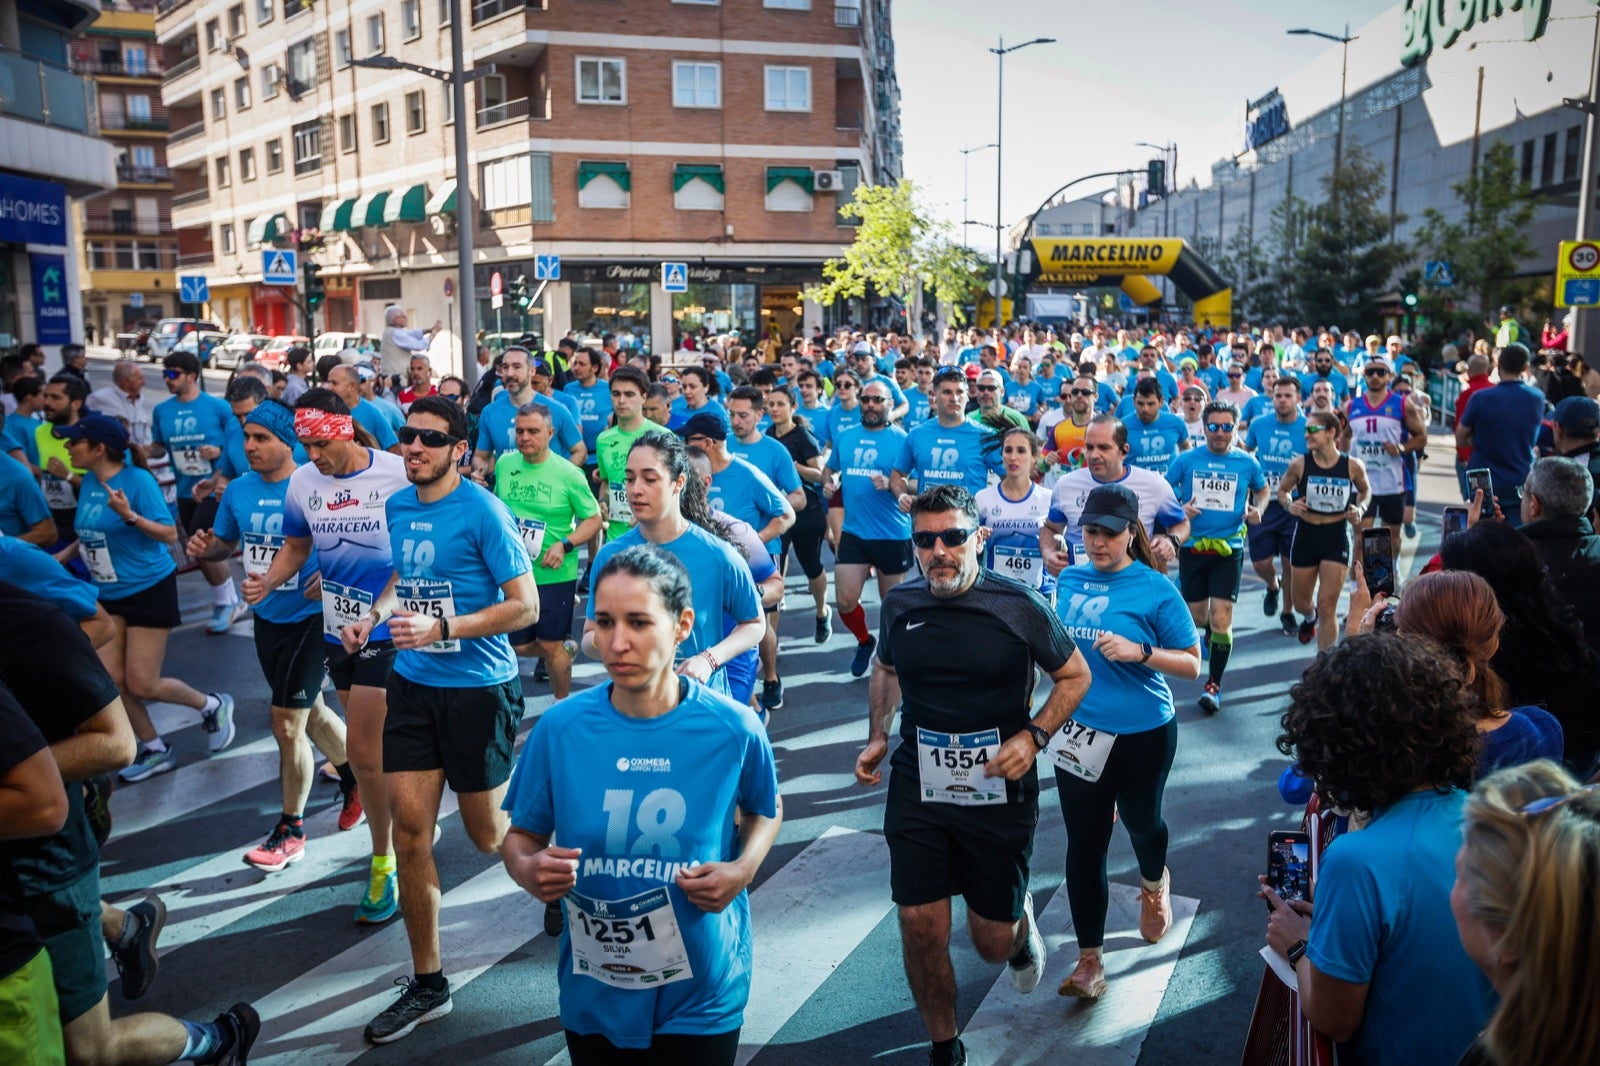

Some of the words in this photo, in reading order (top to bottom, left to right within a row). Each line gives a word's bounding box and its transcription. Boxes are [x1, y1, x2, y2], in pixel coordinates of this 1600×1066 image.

[1051, 244, 1163, 261] MARCELINO
[1576, 251, 1596, 263] 30
[1366, 419, 1377, 433] 11
[1141, 436, 1165, 455] 18
[854, 447, 878, 467] 18
[931, 447, 959, 469] 18
[924, 470, 964, 480] MARCELINO
[1200, 479, 1230, 492] 1468
[1314, 485, 1344, 497] 1016
[312, 520, 380, 533] MARACENA
[402, 539, 435, 577] 18
[1005, 557, 1031, 570] 466
[334, 596, 361, 617] 334
[1064, 593, 1110, 626] 18
[631, 758, 671, 766] OXIMESA
[931, 748, 989, 769] 1554
[603, 788, 687, 857] 18
[578, 911, 655, 944] 1251
[603, 945, 631, 953] SILVIA
